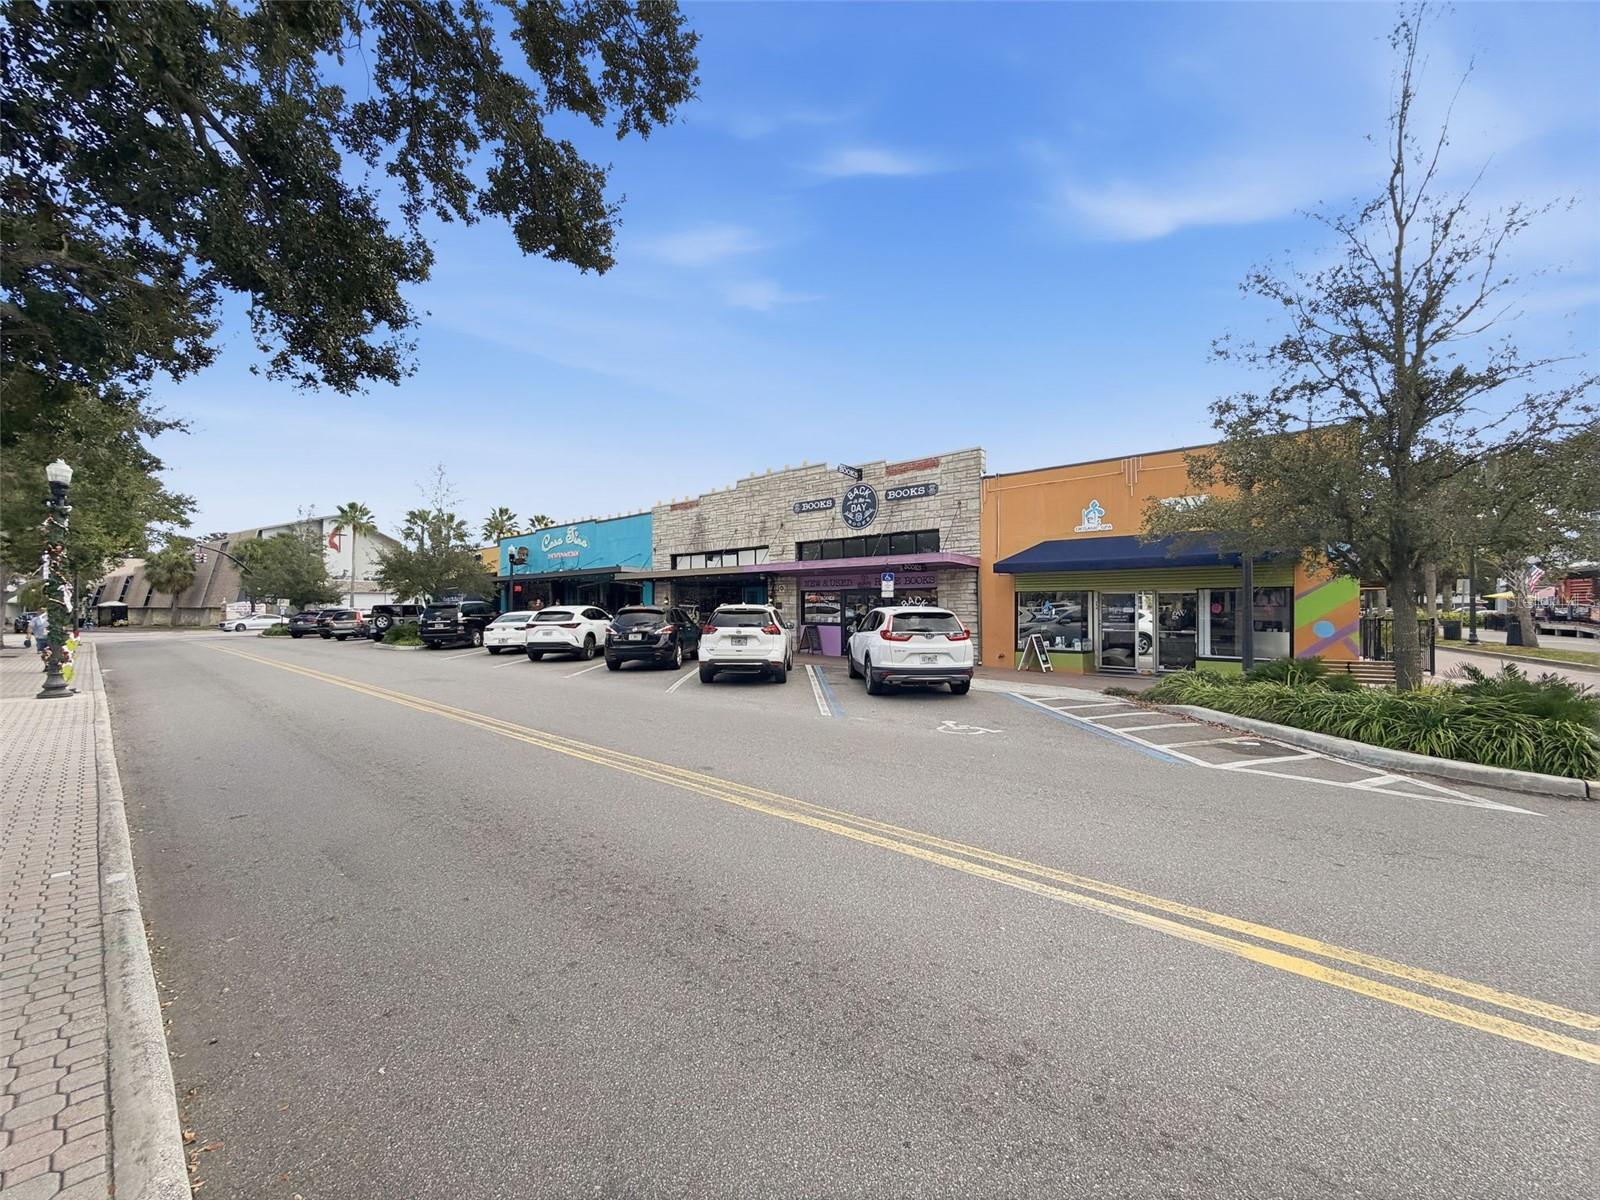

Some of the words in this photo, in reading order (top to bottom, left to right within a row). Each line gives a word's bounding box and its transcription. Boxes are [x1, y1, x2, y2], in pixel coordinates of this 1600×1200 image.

[838, 465, 859, 479] BOOKS
[847, 486, 872, 500] BACK
[887, 487, 926, 500] BOOKS
[801, 500, 832, 511] BOOKS
[850, 502, 867, 513] DAY
[904, 575, 936, 586] BOOKS
